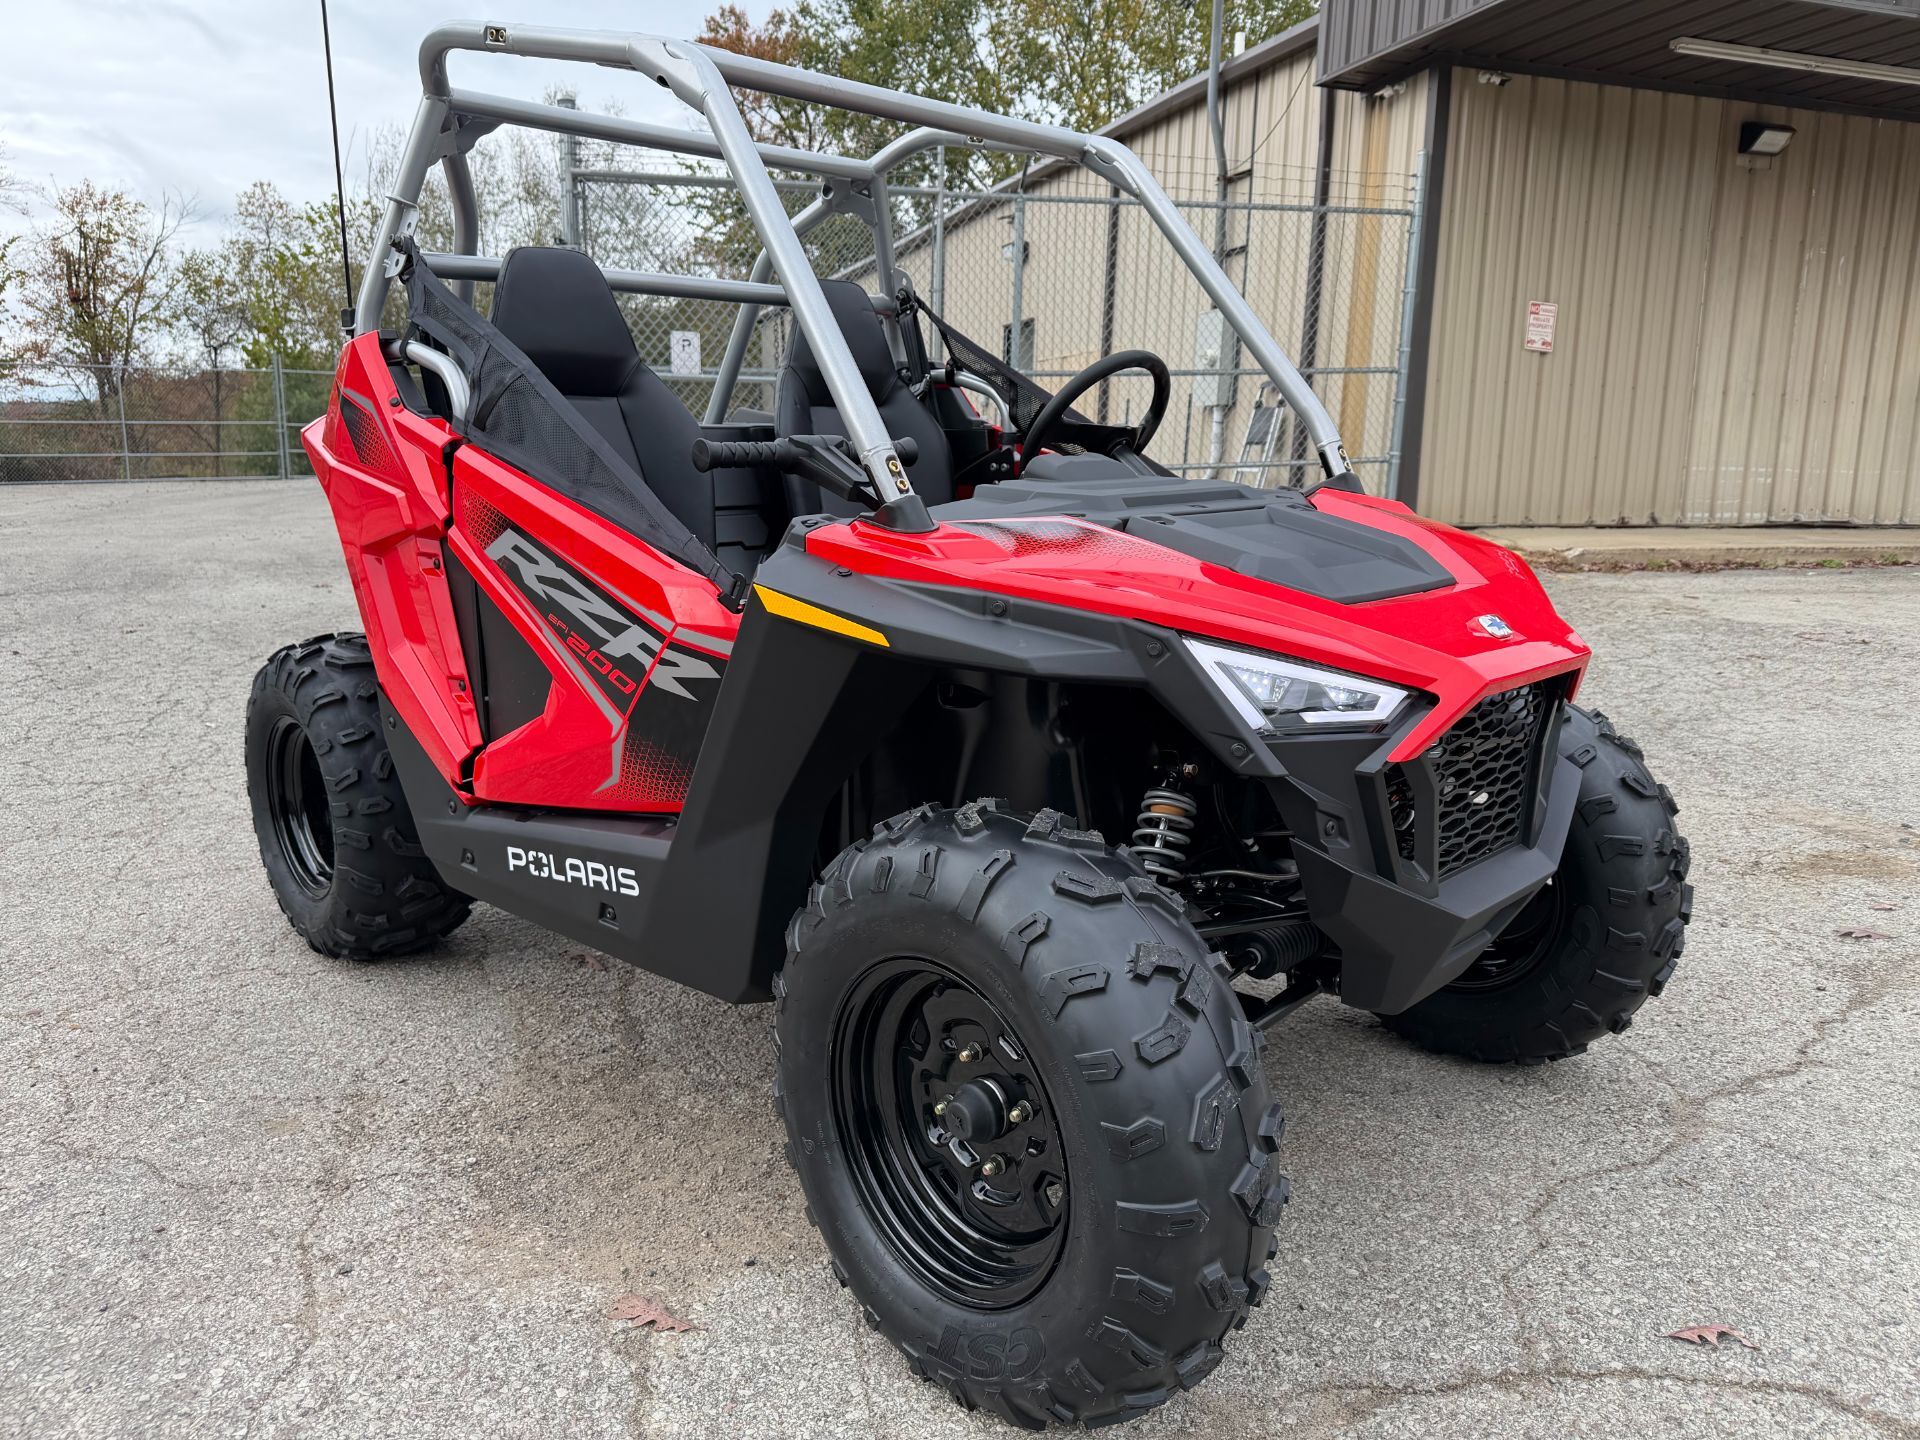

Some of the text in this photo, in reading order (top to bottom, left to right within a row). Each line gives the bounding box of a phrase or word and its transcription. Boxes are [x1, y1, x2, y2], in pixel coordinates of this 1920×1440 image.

[485, 528, 722, 702] RZR
[548, 613, 569, 634] EFI
[566, 631, 637, 695] 200
[507, 846, 640, 897] POLARIS
[926, 1324, 1047, 1381] CST
